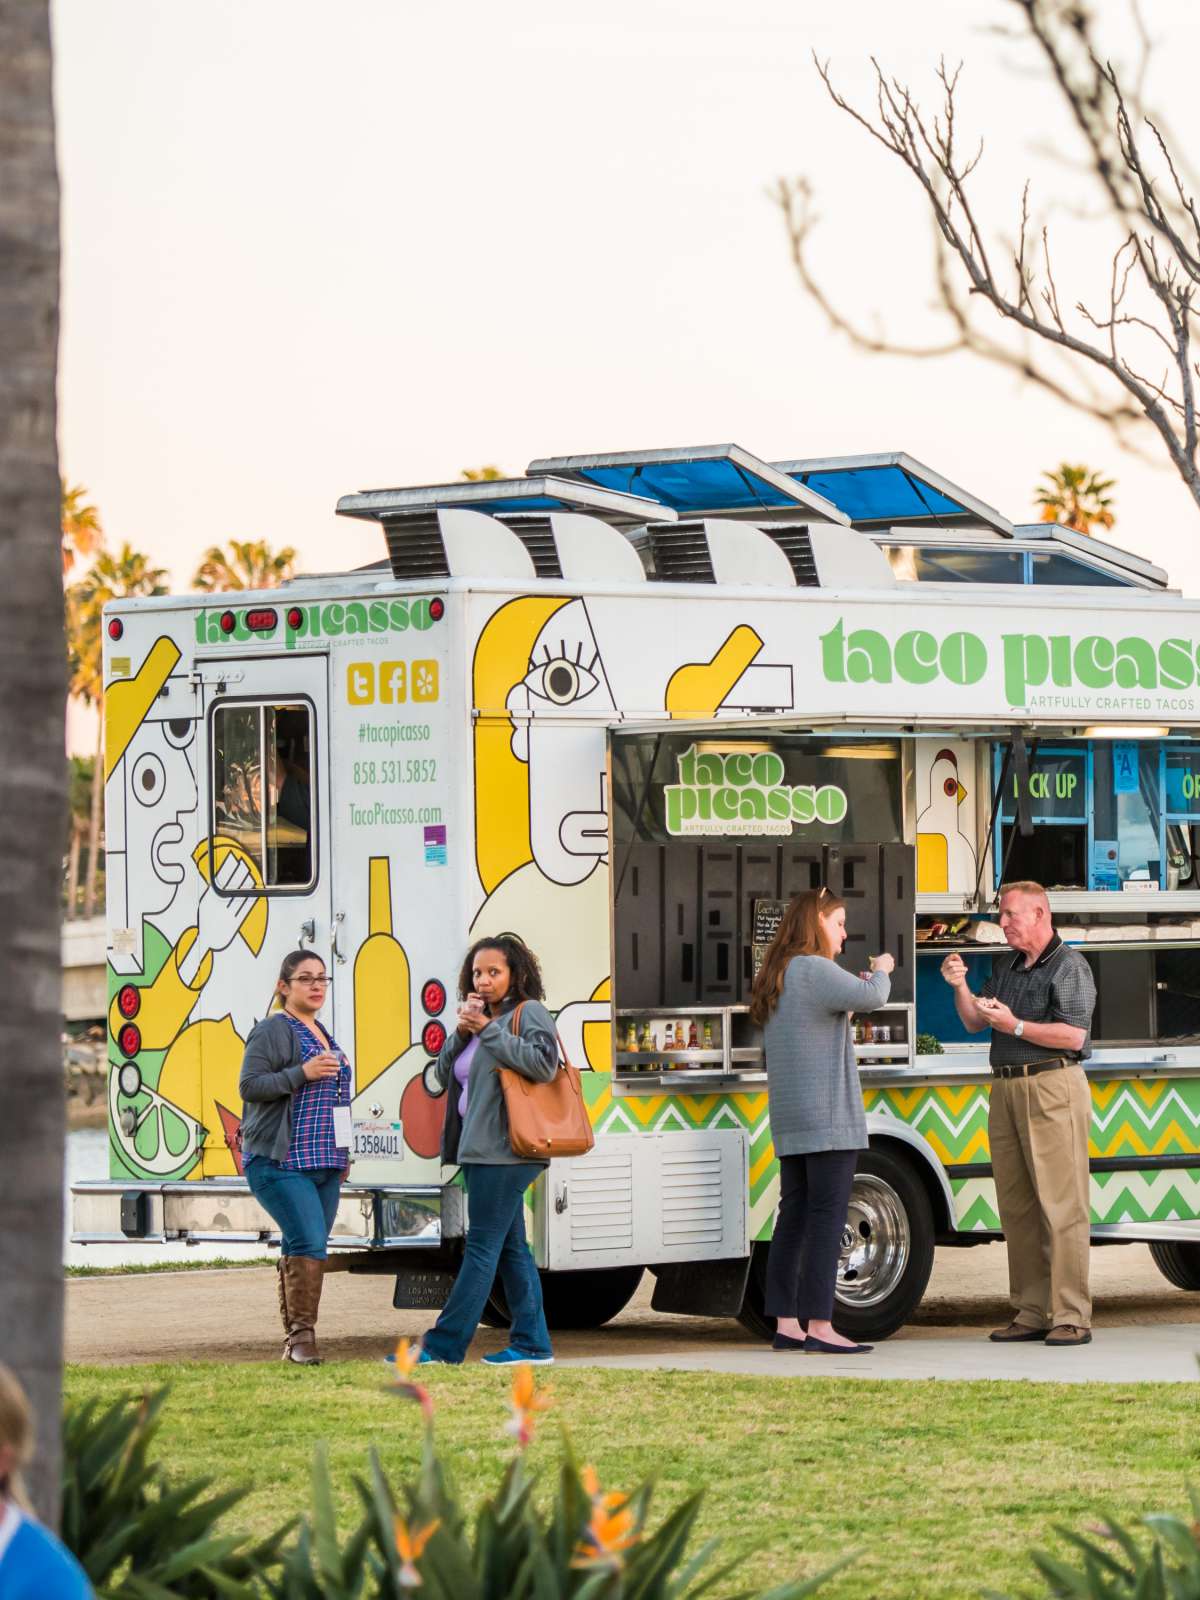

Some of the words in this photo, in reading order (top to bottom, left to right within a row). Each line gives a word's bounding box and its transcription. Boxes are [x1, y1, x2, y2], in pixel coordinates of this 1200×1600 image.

[284, 598, 434, 649] picasso
[819, 616, 988, 686] taco
[1030, 696, 1091, 708] ARTFULLY
[1096, 698, 1151, 709] CRAFTED
[1157, 699, 1194, 710] TACOS
[358, 720, 430, 747] #tacopicasso
[353, 760, 437, 784] 858.531.5852
[678, 744, 784, 787] taco
[1056, 774, 1077, 798] UP
[349, 803, 442, 825] TacoPicasso.com
[665, 786, 847, 832] picasso
[684, 824, 722, 832] ARTFULLY
[726, 824, 762, 832] CRAFTED
[765, 824, 791, 832] TACOS
[354, 1135, 399, 1154] 13584U1
